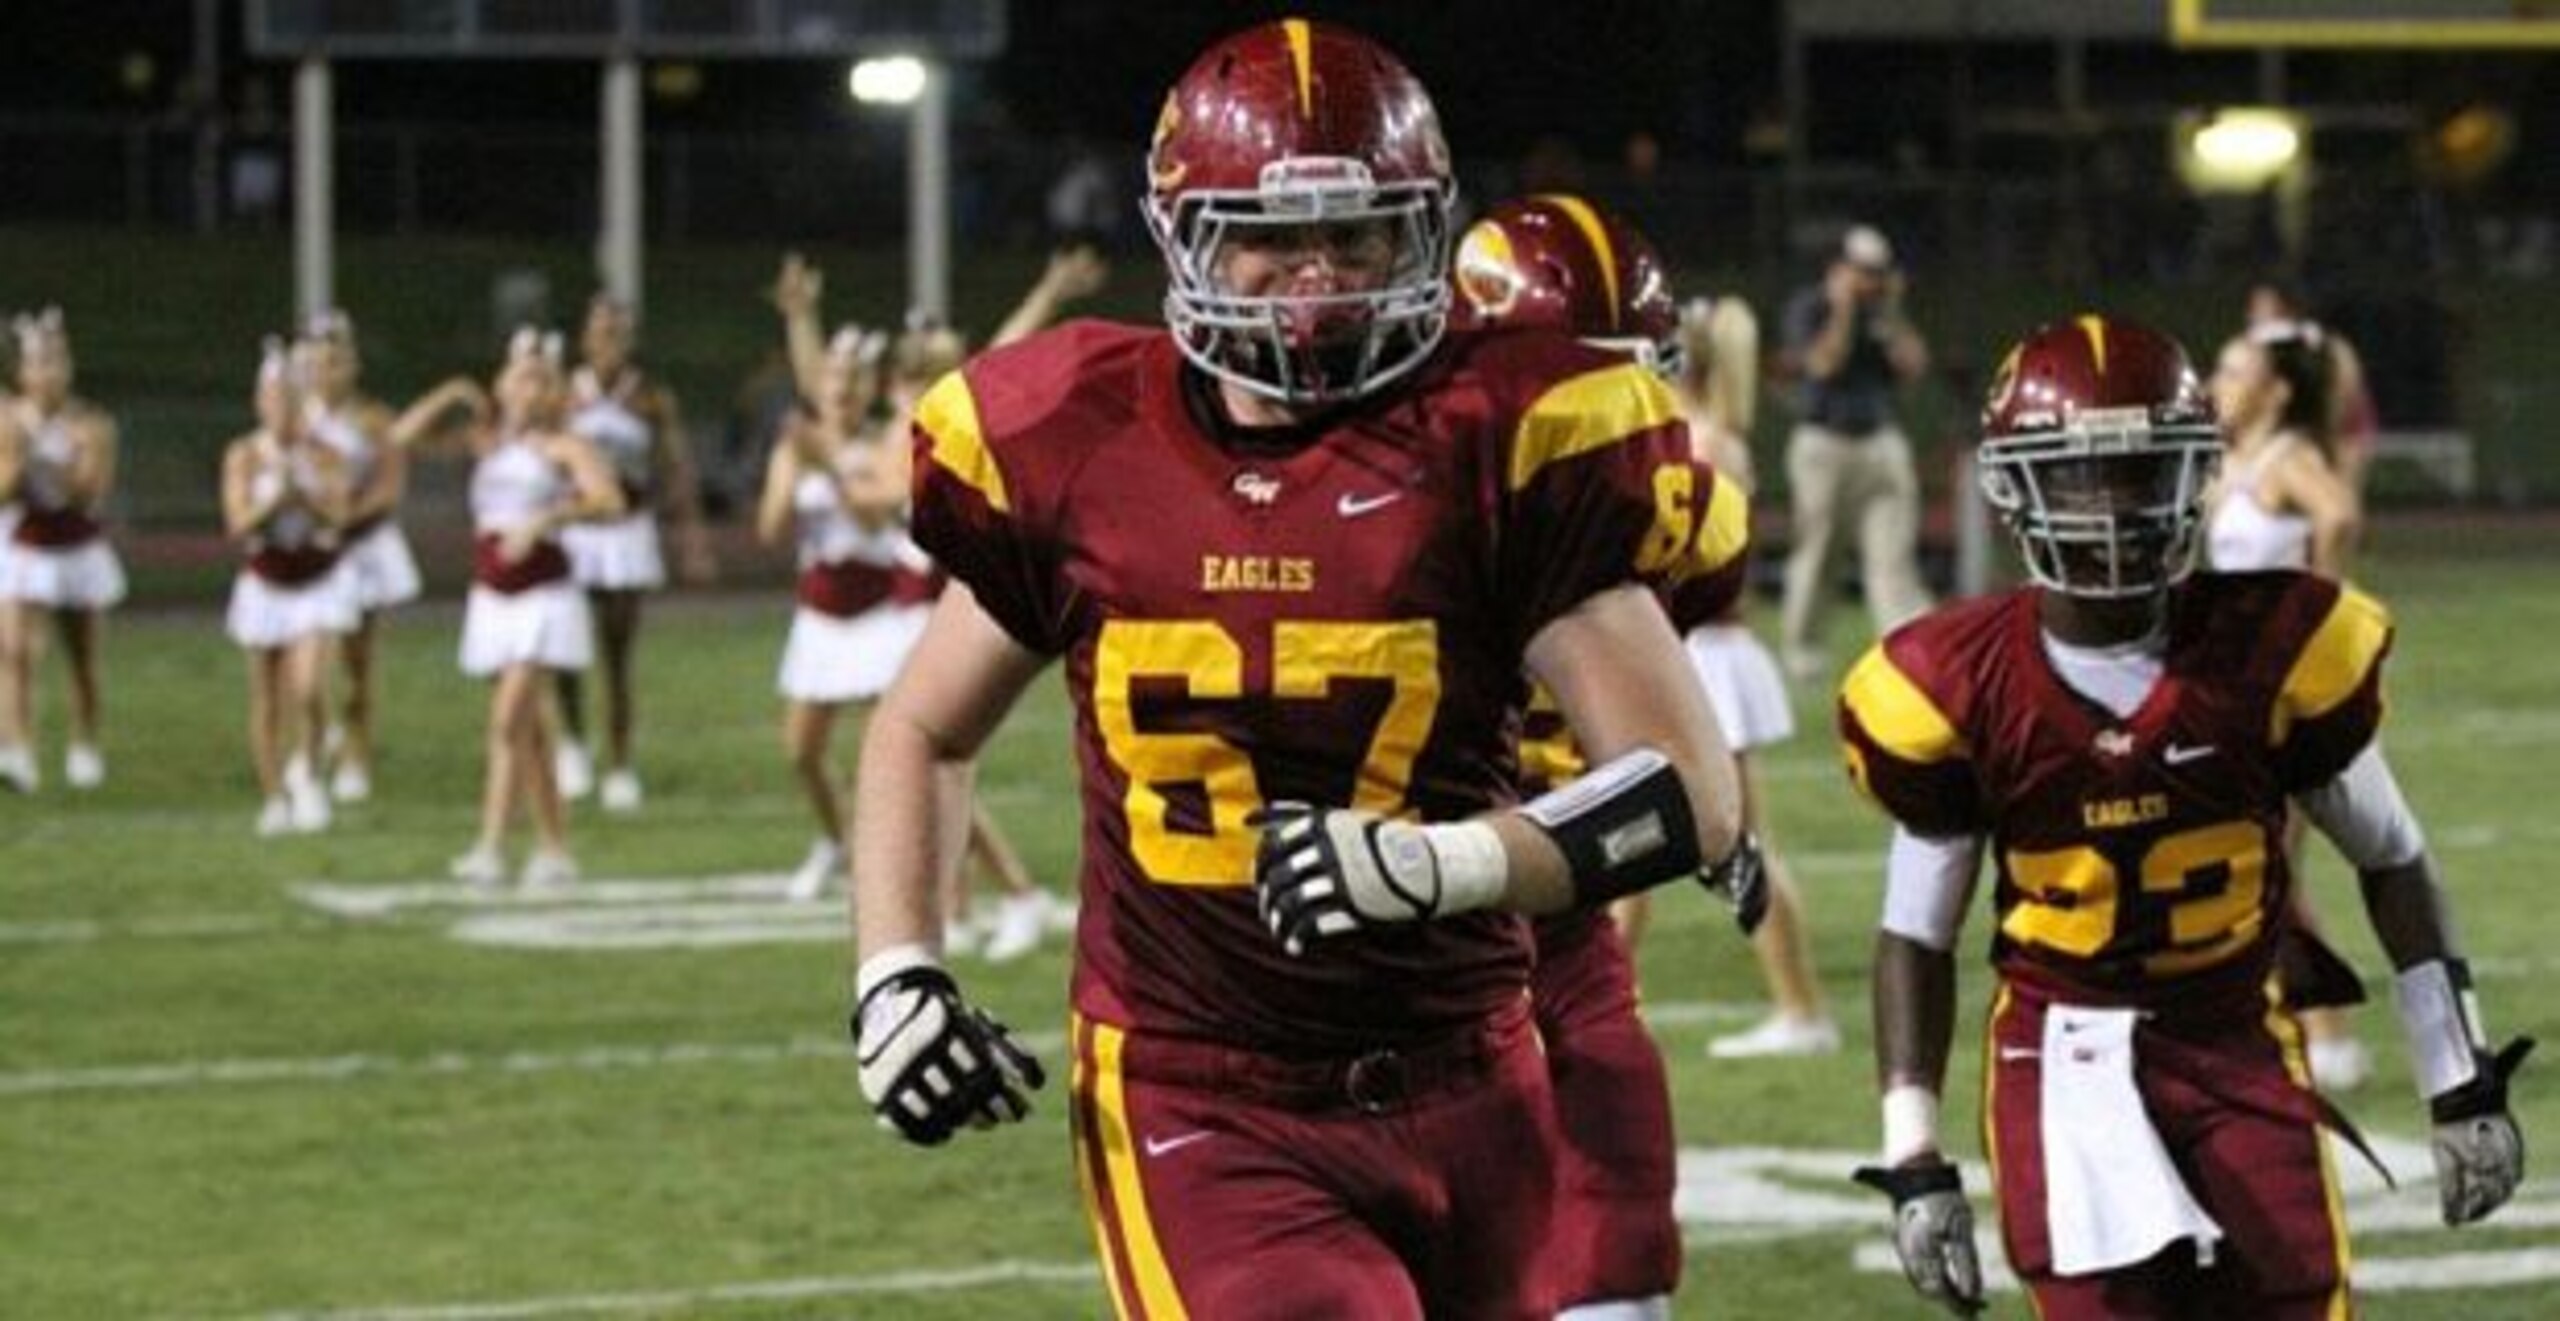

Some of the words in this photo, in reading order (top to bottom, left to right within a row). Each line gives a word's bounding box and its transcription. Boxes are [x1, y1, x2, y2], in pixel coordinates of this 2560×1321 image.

[1202, 555, 1315, 591] EAGLES
[1094, 620, 1440, 884] 67
[2001, 819, 2266, 974] 23
